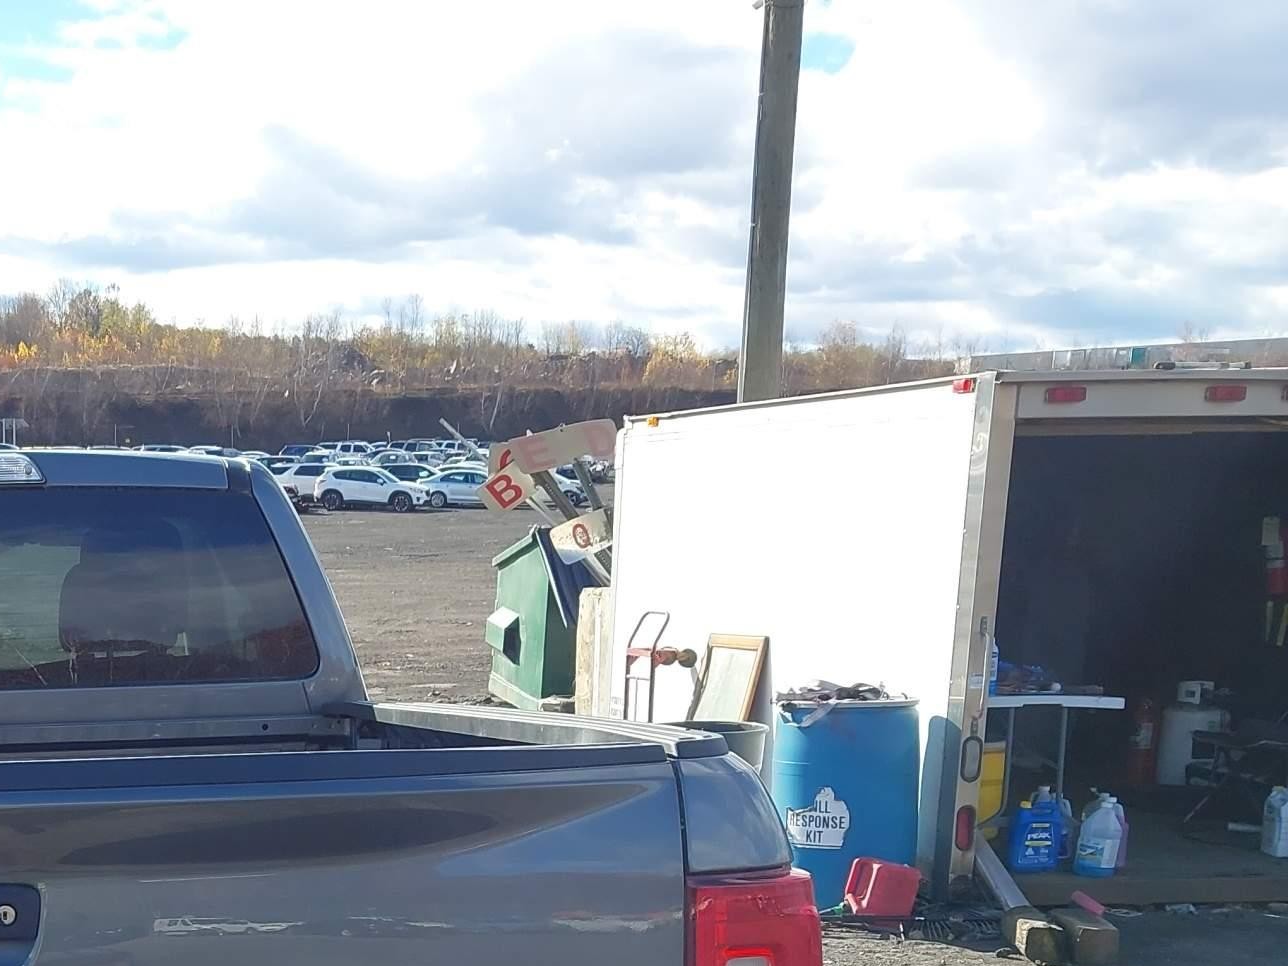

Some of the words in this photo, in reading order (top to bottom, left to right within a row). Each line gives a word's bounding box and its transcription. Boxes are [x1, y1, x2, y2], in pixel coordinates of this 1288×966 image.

[485, 474, 523, 509] B
[789, 813, 847, 830] RESPONSE
[806, 830, 823, 843] KIT
